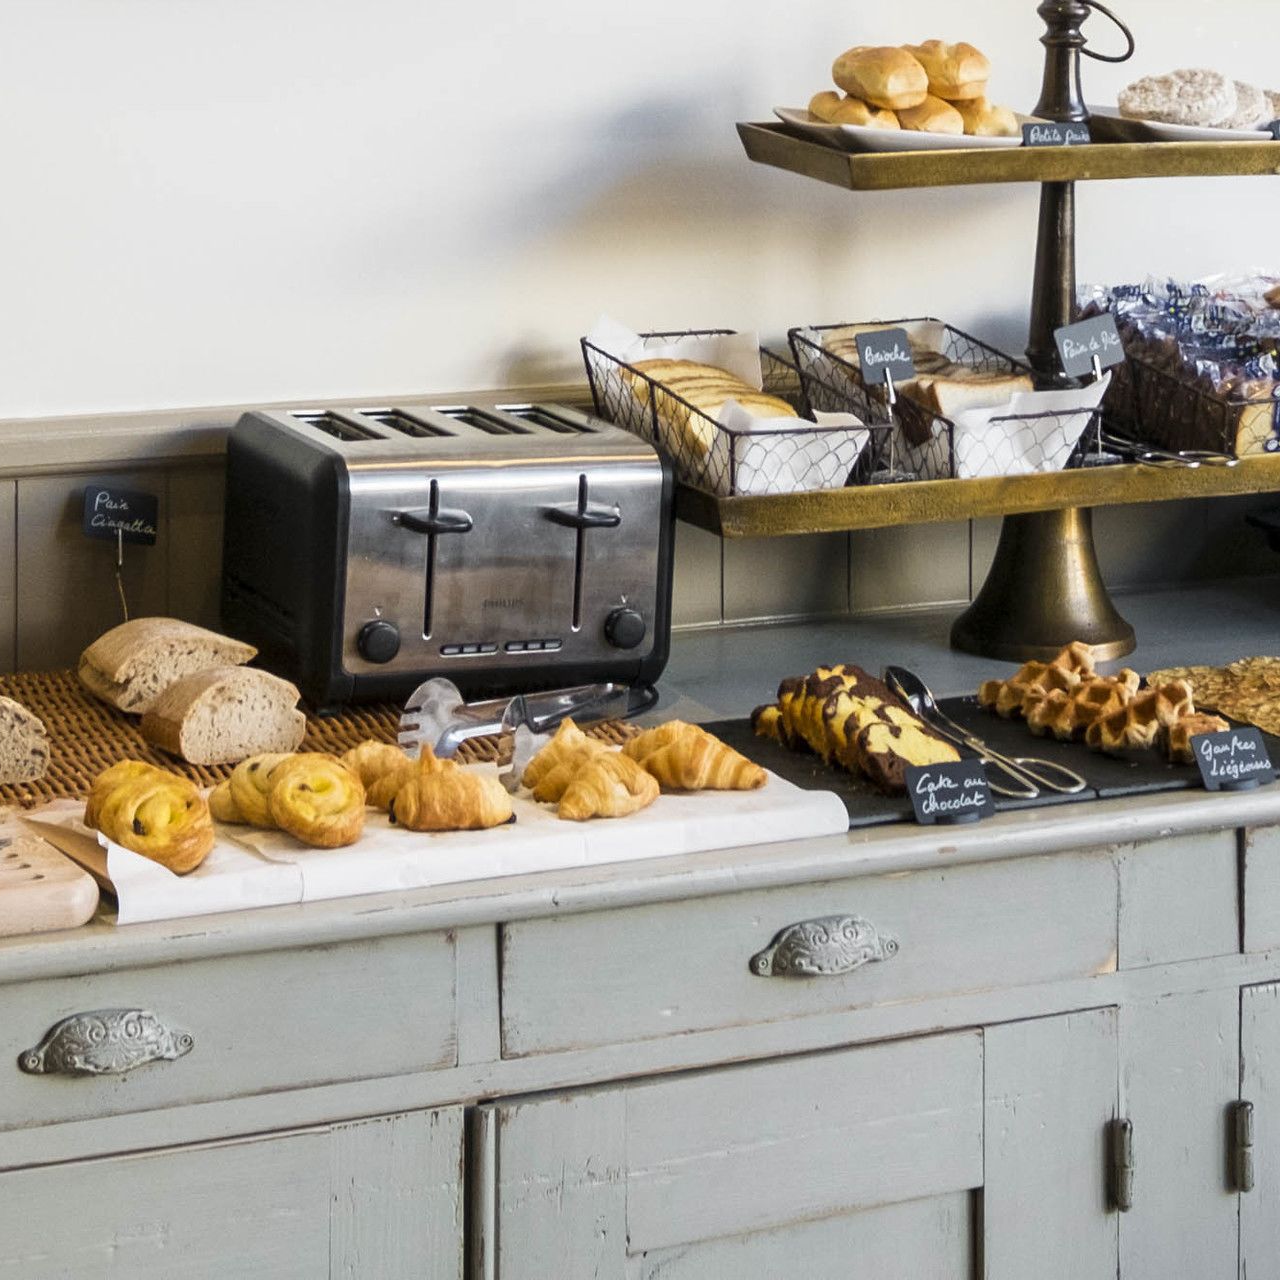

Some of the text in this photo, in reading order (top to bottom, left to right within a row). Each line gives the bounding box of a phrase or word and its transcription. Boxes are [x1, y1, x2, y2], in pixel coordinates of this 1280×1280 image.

[864, 341, 911, 366] Brioche
[94, 491, 129, 512] Pain
[916, 773, 987, 794] Cake au
